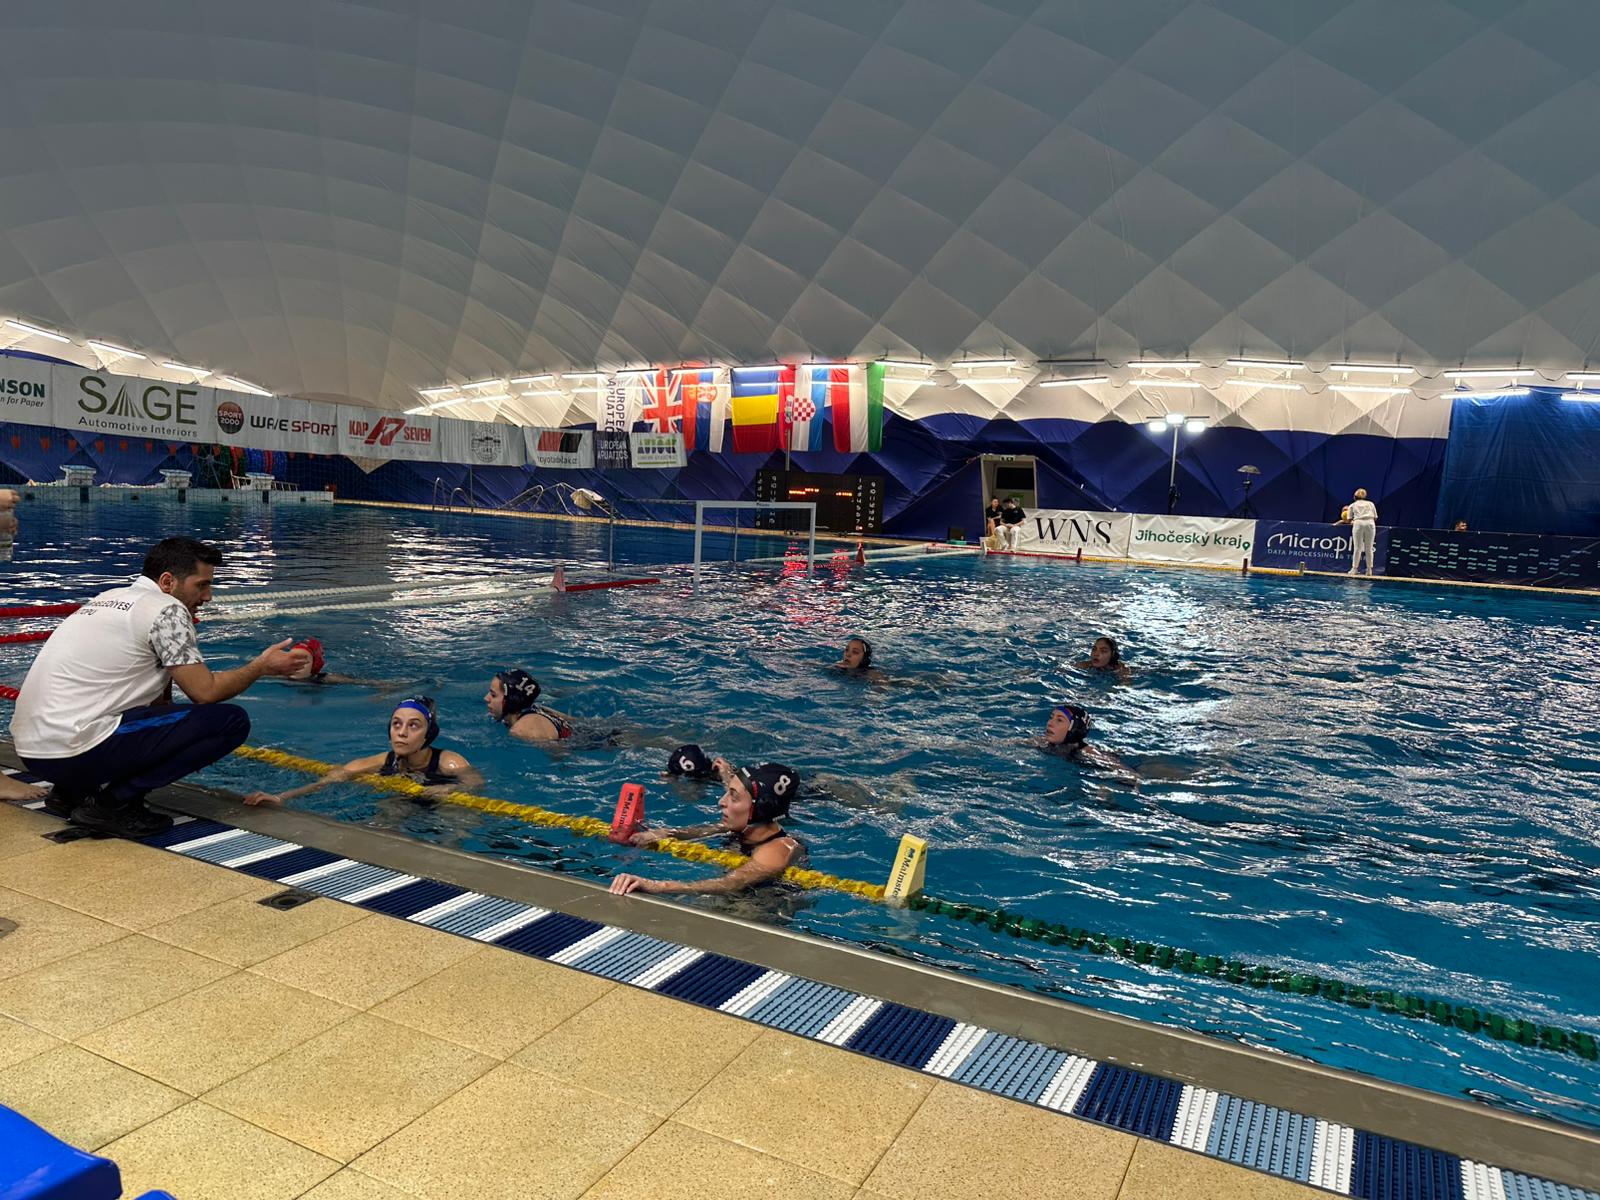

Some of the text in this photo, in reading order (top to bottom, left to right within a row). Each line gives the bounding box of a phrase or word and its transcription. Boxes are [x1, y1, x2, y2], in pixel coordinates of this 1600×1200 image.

[7, 395, 19, 405] for
[20, 398, 44, 408] Paper
[78, 375, 198, 425] SAGE
[218, 409, 242, 419] SPORT
[220, 417, 240, 426] 2000
[79, 416, 198, 438] Automotive Interiors
[291, 420, 338, 437] SPORT
[403, 426, 432, 442] SEVEN
[1034, 517, 1113, 544] WNS
[1135, 529, 1243, 549] Jihočeský kraj
[1266, 533, 1377, 560] Micropls
[1267, 548, 1286, 556] DATA
[1288, 549, 1335, 559] PROCESSING
[515, 676, 536, 697] 14
[679, 755, 696, 771] 6
[773, 774, 791, 796] 8
